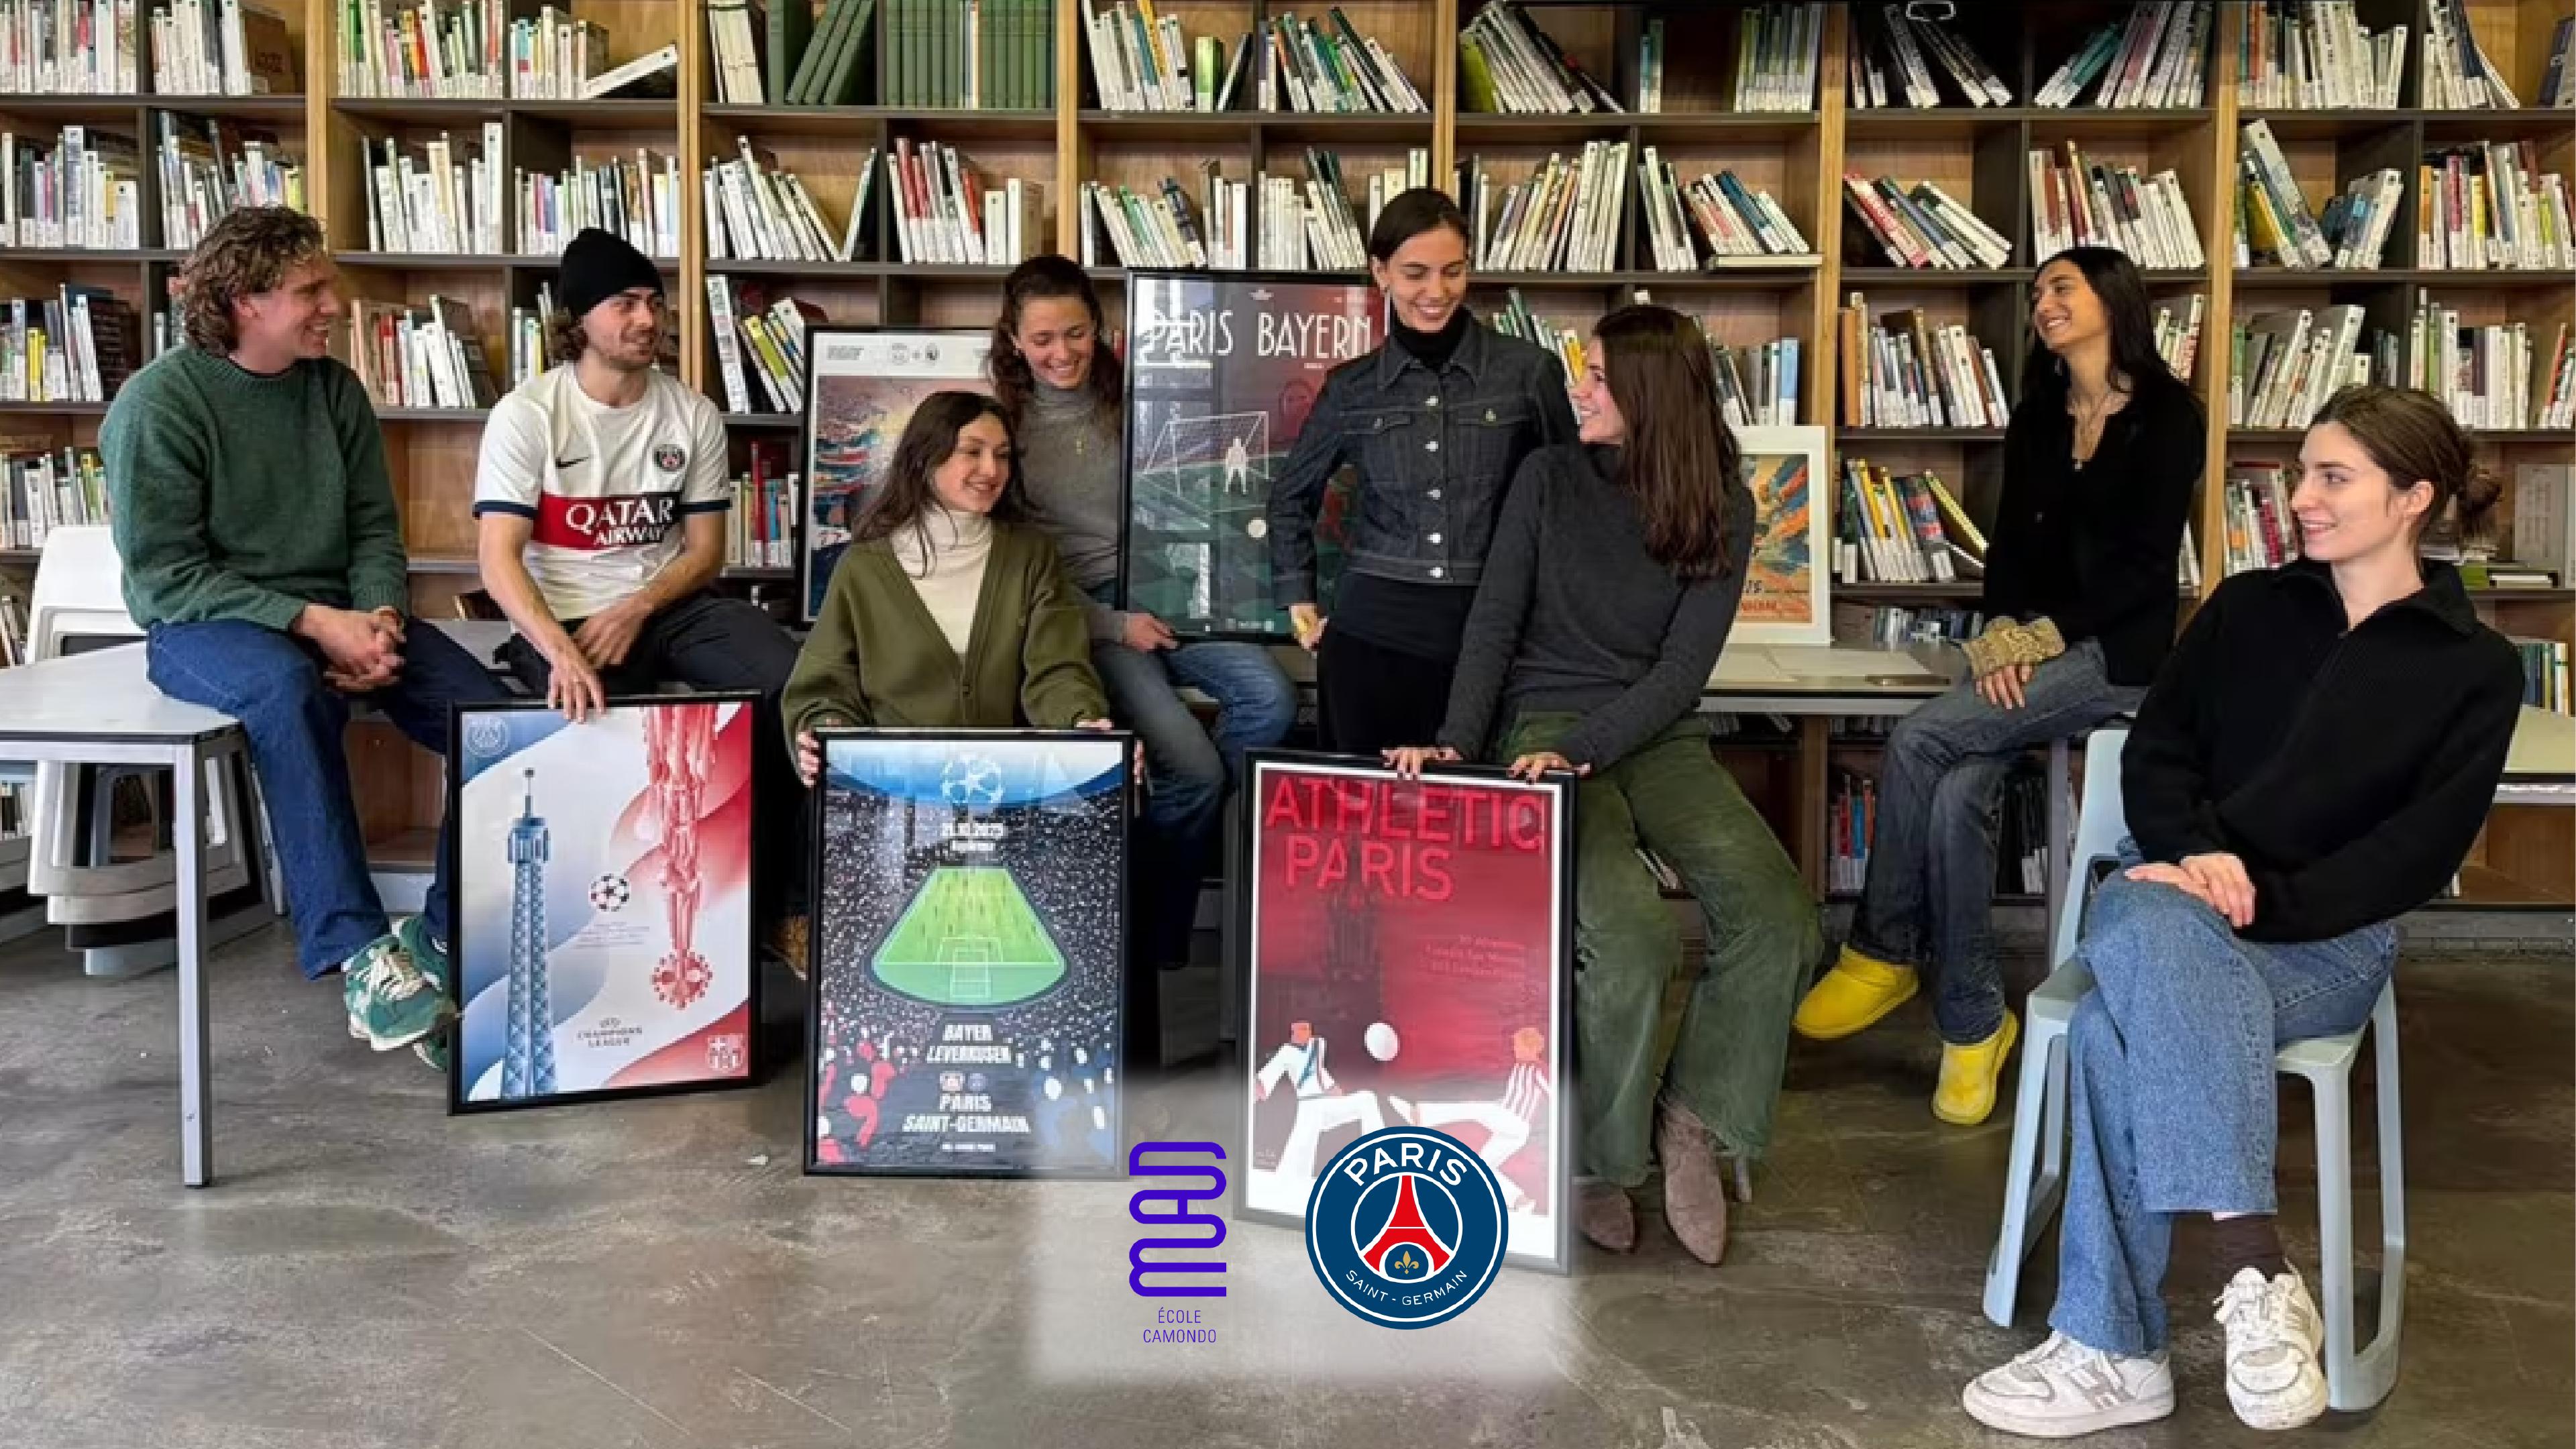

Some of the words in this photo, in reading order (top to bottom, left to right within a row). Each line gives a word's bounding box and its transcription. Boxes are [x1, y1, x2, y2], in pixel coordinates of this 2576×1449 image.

[1152, 309, 1234, 356] PARIS
[1257, 311, 1373, 360] BAYERN
[566, 498, 673, 535] QATAR
[595, 526, 661, 545] AIRWAY
[1265, 776, 1544, 850] ATHLETIC
[1286, 834, 1453, 900] PARIS
[944, 1025, 991, 1041] BAYER
[926, 1046, 1010, 1063] LEVERKUSEN
[939, 1095, 991, 1112] PARIS
[903, 1116, 1030, 1132] SAINT-GERMAIN
